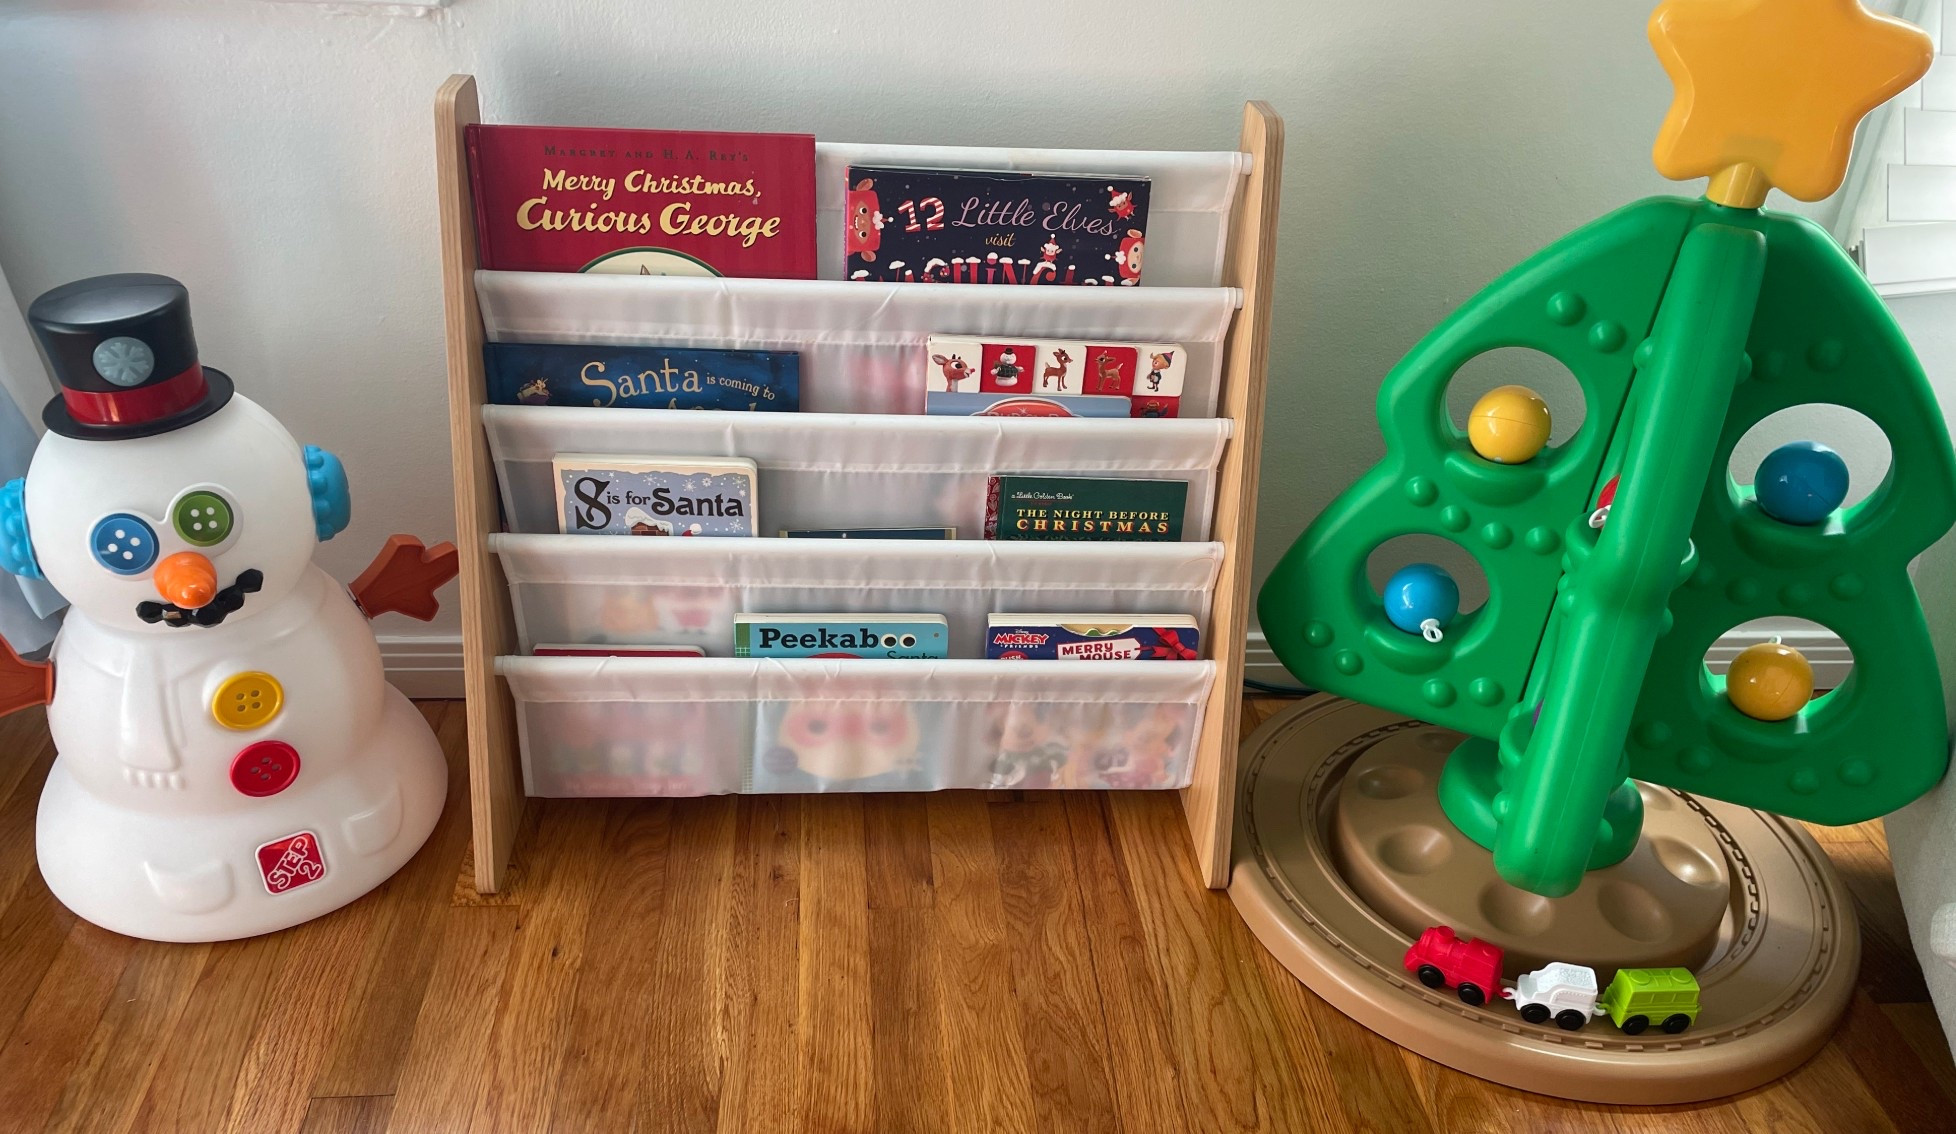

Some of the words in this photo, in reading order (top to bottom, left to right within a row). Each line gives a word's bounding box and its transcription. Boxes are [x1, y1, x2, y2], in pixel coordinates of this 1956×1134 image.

[625, 151, 653, 159] AND
[542, 168, 616, 200] Merry
[624, 169, 762, 199] Christmas,
[516, 196, 652, 235] Curious
[659, 201, 781, 248] George
[897, 197, 946, 233] 12
[951, 196, 1037, 229] Little
[1042, 201, 1119, 235] Elves
[985, 232, 1016, 249] visit
[580, 358, 703, 408] Santa
[706, 372, 717, 386] is
[718, 375, 760, 398] coming
[763, 383, 776, 401] to
[573, 476, 612, 531] S
[607, 490, 621, 505] is
[625, 490, 651, 506] for
[651, 487, 744, 517] Santa
[1016, 508, 1048, 518] THE
[1053, 509, 1103, 519] NIGHT
[1109, 511, 1170, 521] BEFORE
[1016, 518, 1170, 534] CHRISTMAS
[993, 632, 1050, 645] MICKEY
[1062, 642, 1114, 655] MERRY
[1079, 650, 1132, 660] MOUSE
[266, 836, 308, 890] STEP
[298, 860, 322, 880] 2
